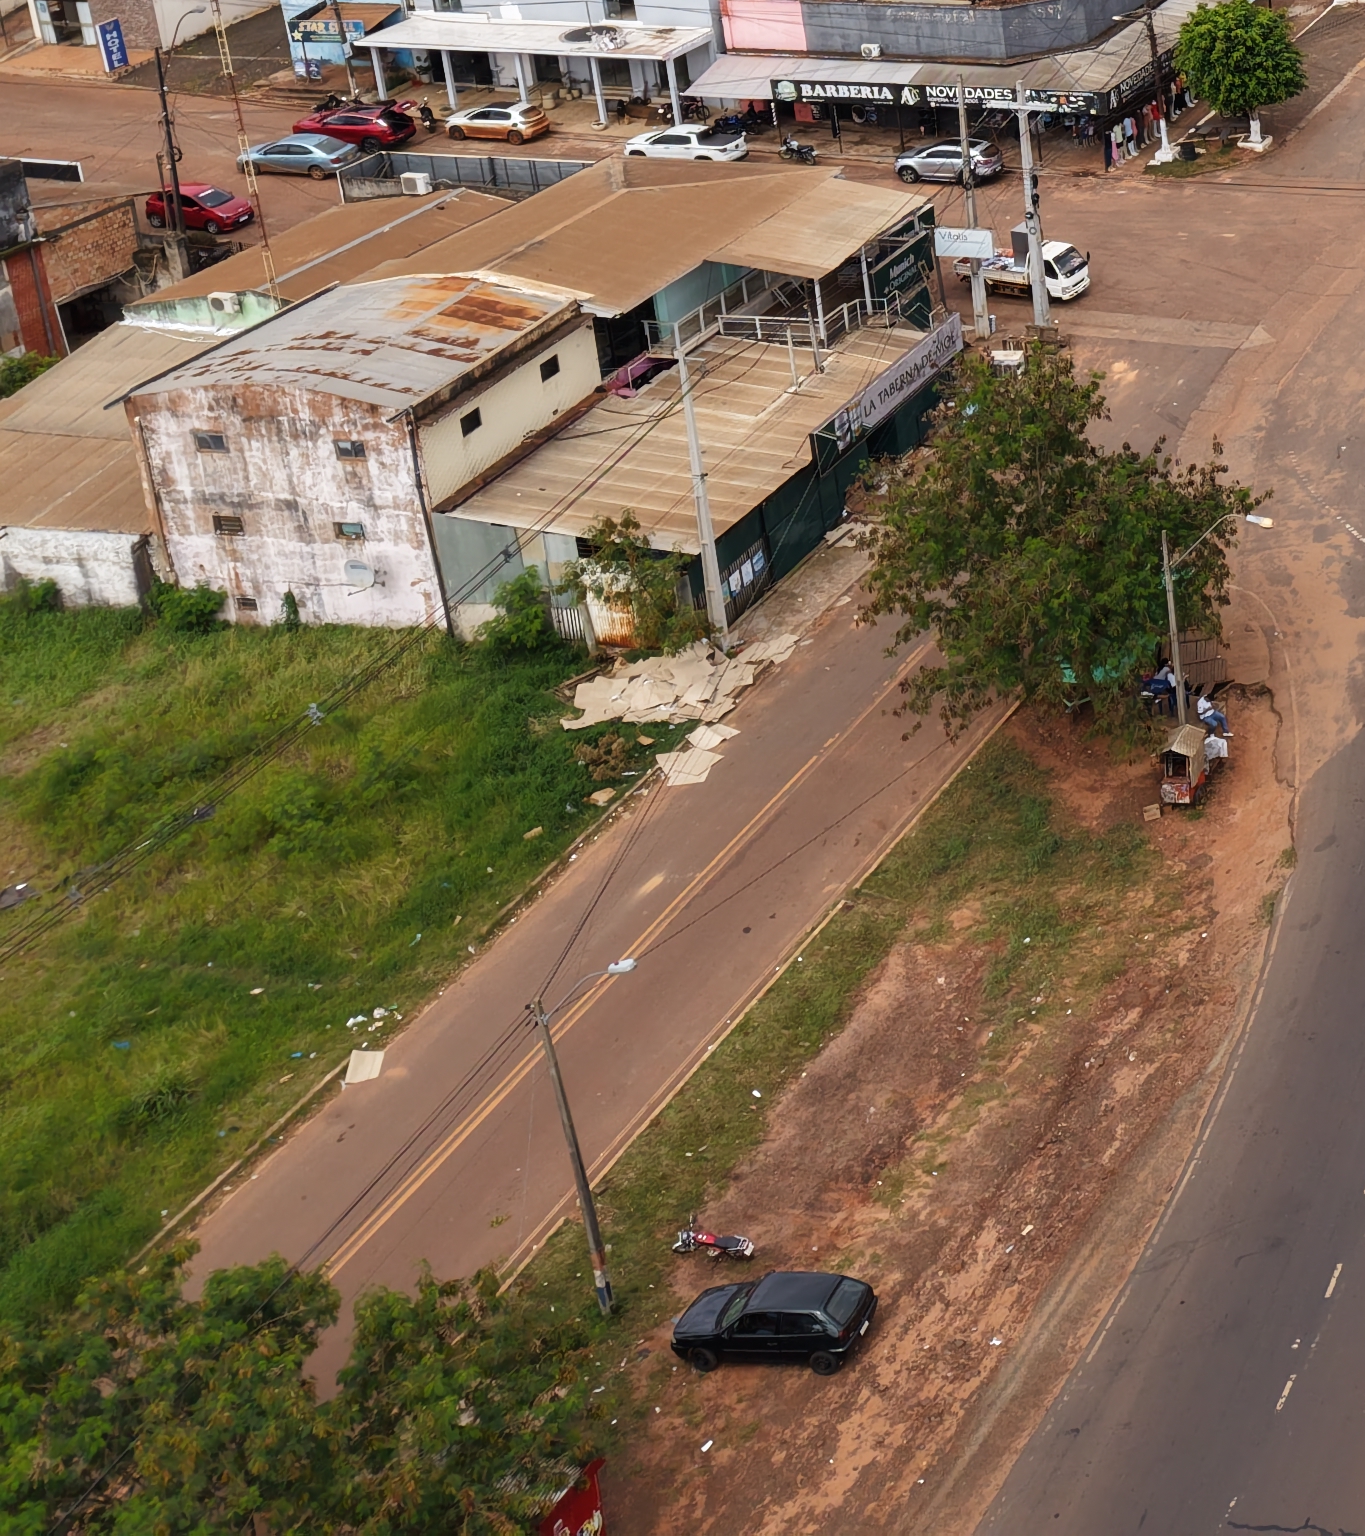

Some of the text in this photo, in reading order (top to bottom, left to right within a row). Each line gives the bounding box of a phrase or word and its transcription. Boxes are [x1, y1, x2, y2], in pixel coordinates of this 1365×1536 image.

[298, 21, 326, 33] STAR
[105, 30, 125, 68] HOTEL
[800, 83, 894, 101] BARBERIA
[889, 253, 915, 279] Munich
[863, 399, 877, 417] LA
[877, 363, 921, 405] TABERNA
